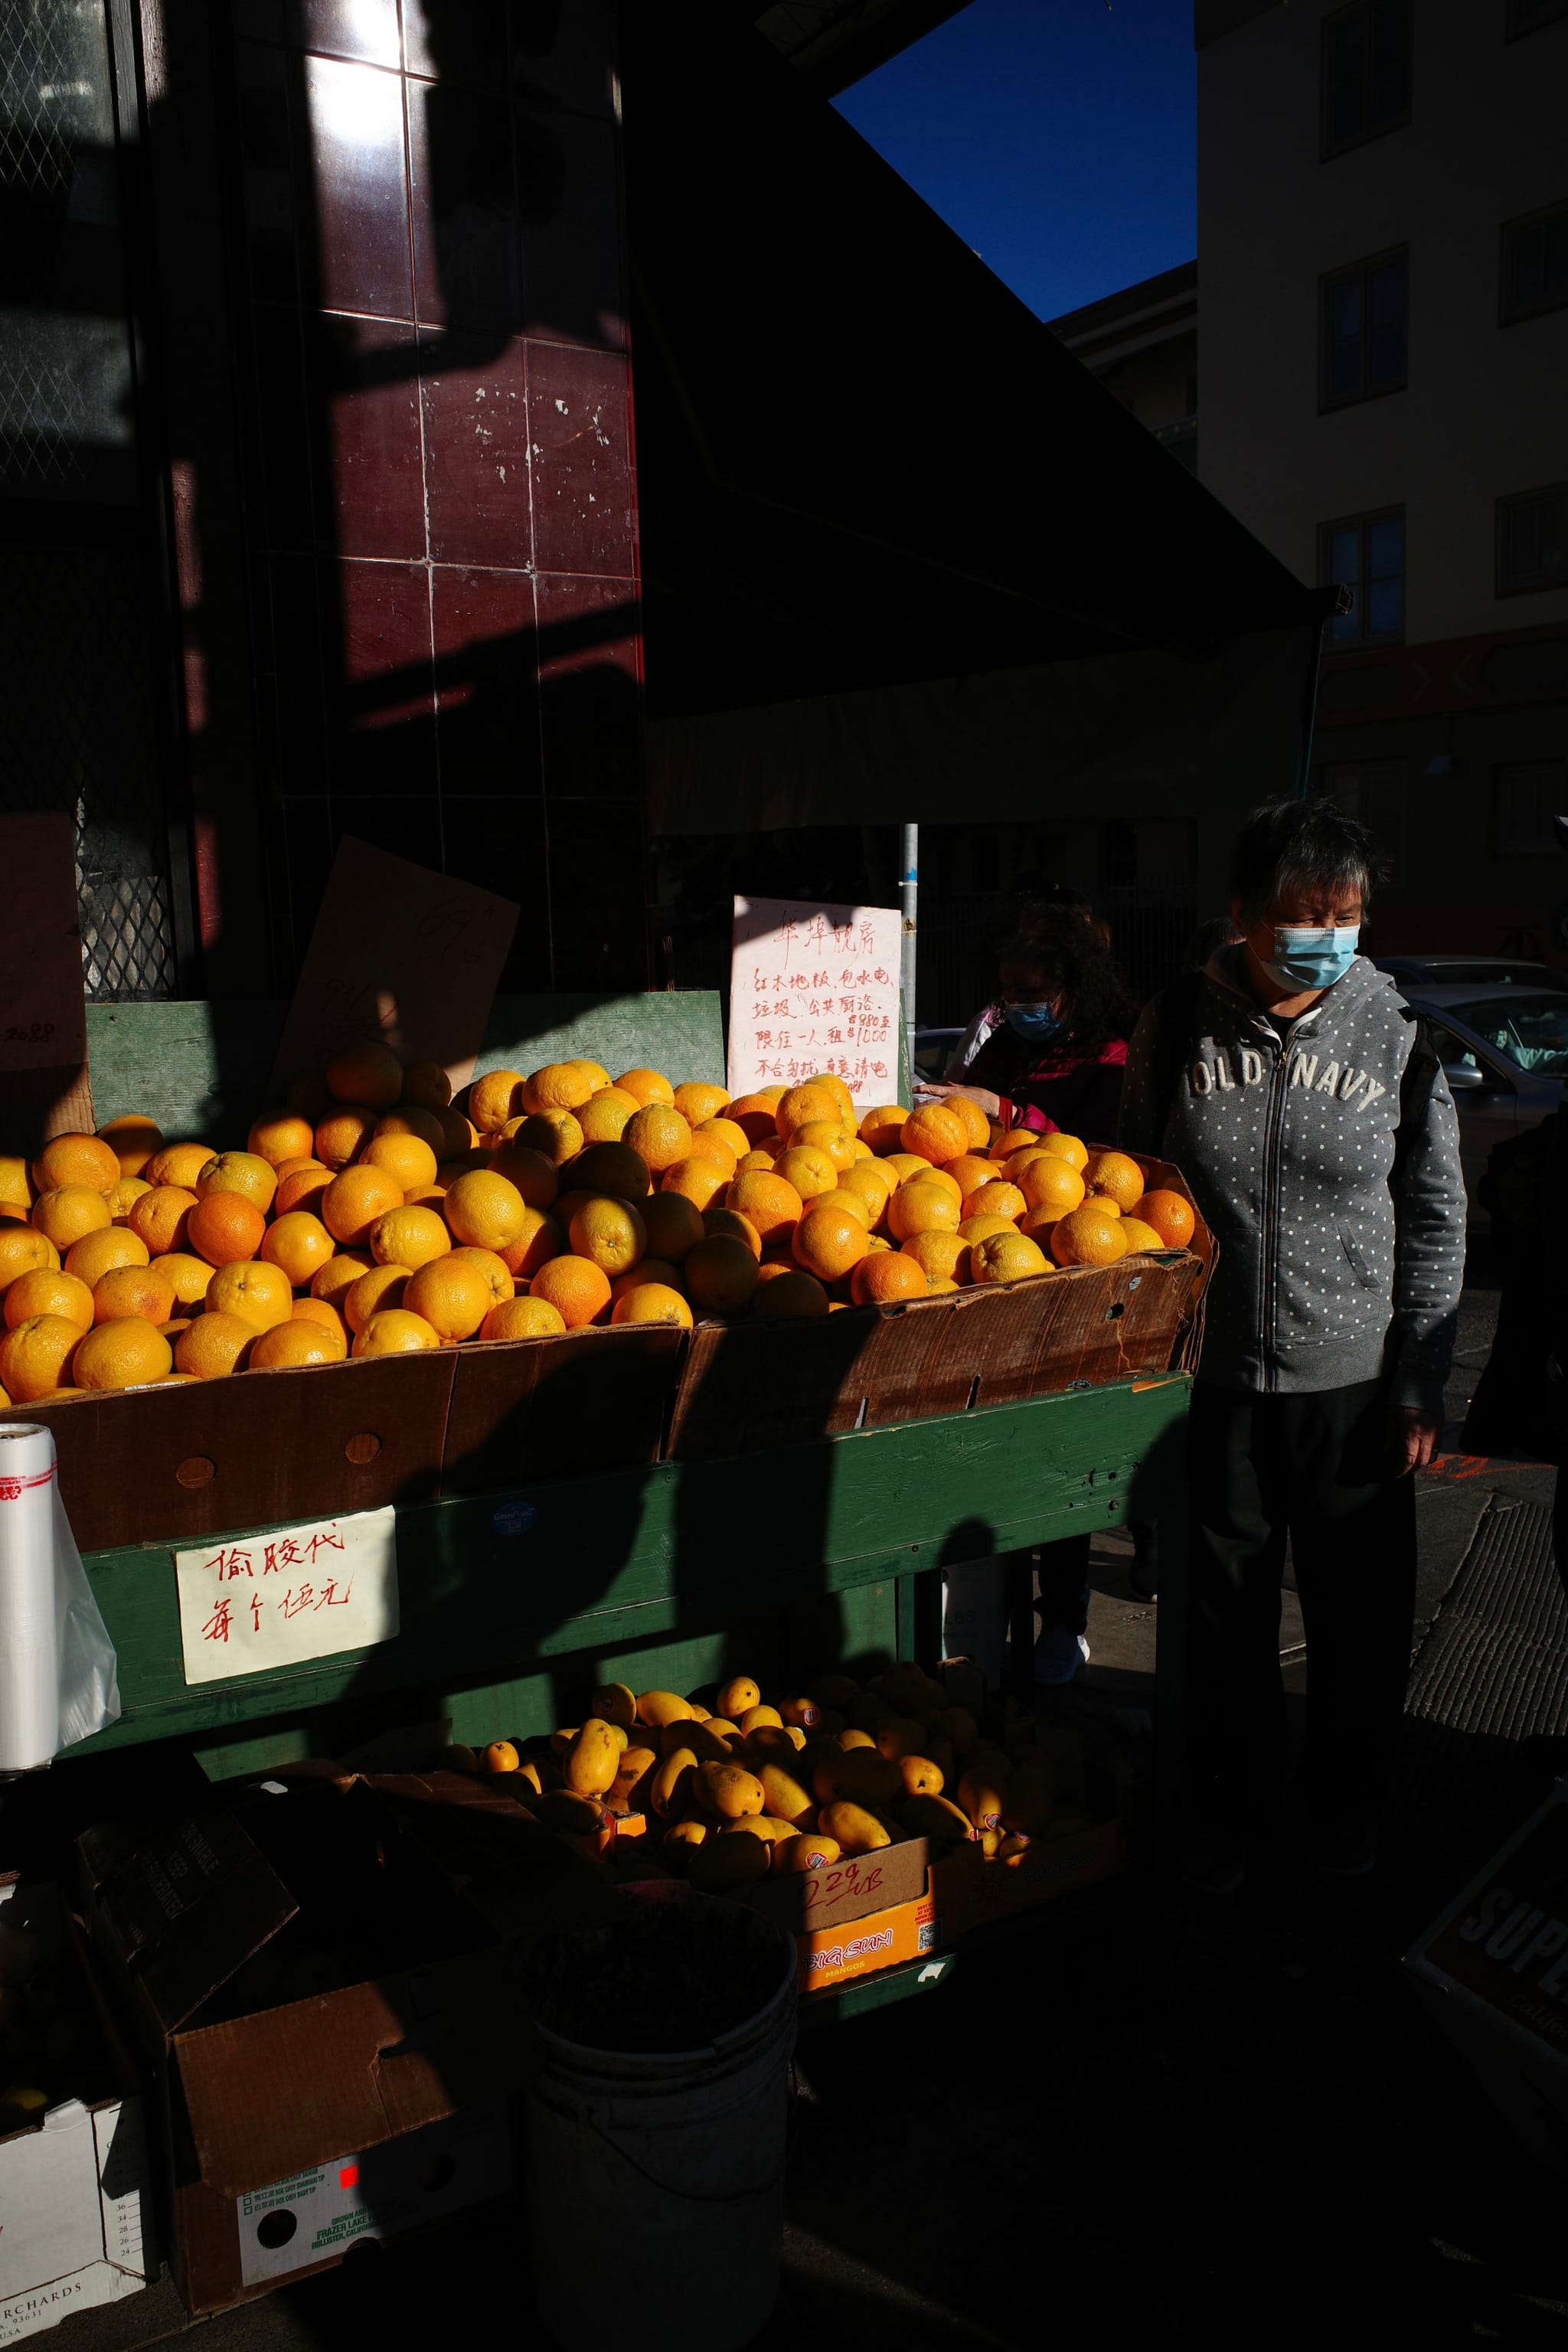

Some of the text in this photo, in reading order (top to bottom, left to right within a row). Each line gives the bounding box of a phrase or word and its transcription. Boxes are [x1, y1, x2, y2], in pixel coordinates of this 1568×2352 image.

[1191, 1050, 1387, 1112] OLD NAVY
[803, 1928, 894, 1973] BIG SUN
[825, 1960, 866, 1979] MANGOS
[116, 2202, 126, 2212] 36
[117, 2214, 127, 2223] 34
[331, 2212, 354, 2226] GROWN
[354, 2207, 367, 2219] AND
[119, 2225, 129, 2234] 28
[316, 2223, 347, 2240] FRAZER
[348, 2215, 368, 2229] LAKE
[119, 2236, 129, 2246] 26
[120, 2247, 131, 2257] 24
[12, 2309, 42, 2325] 93631
